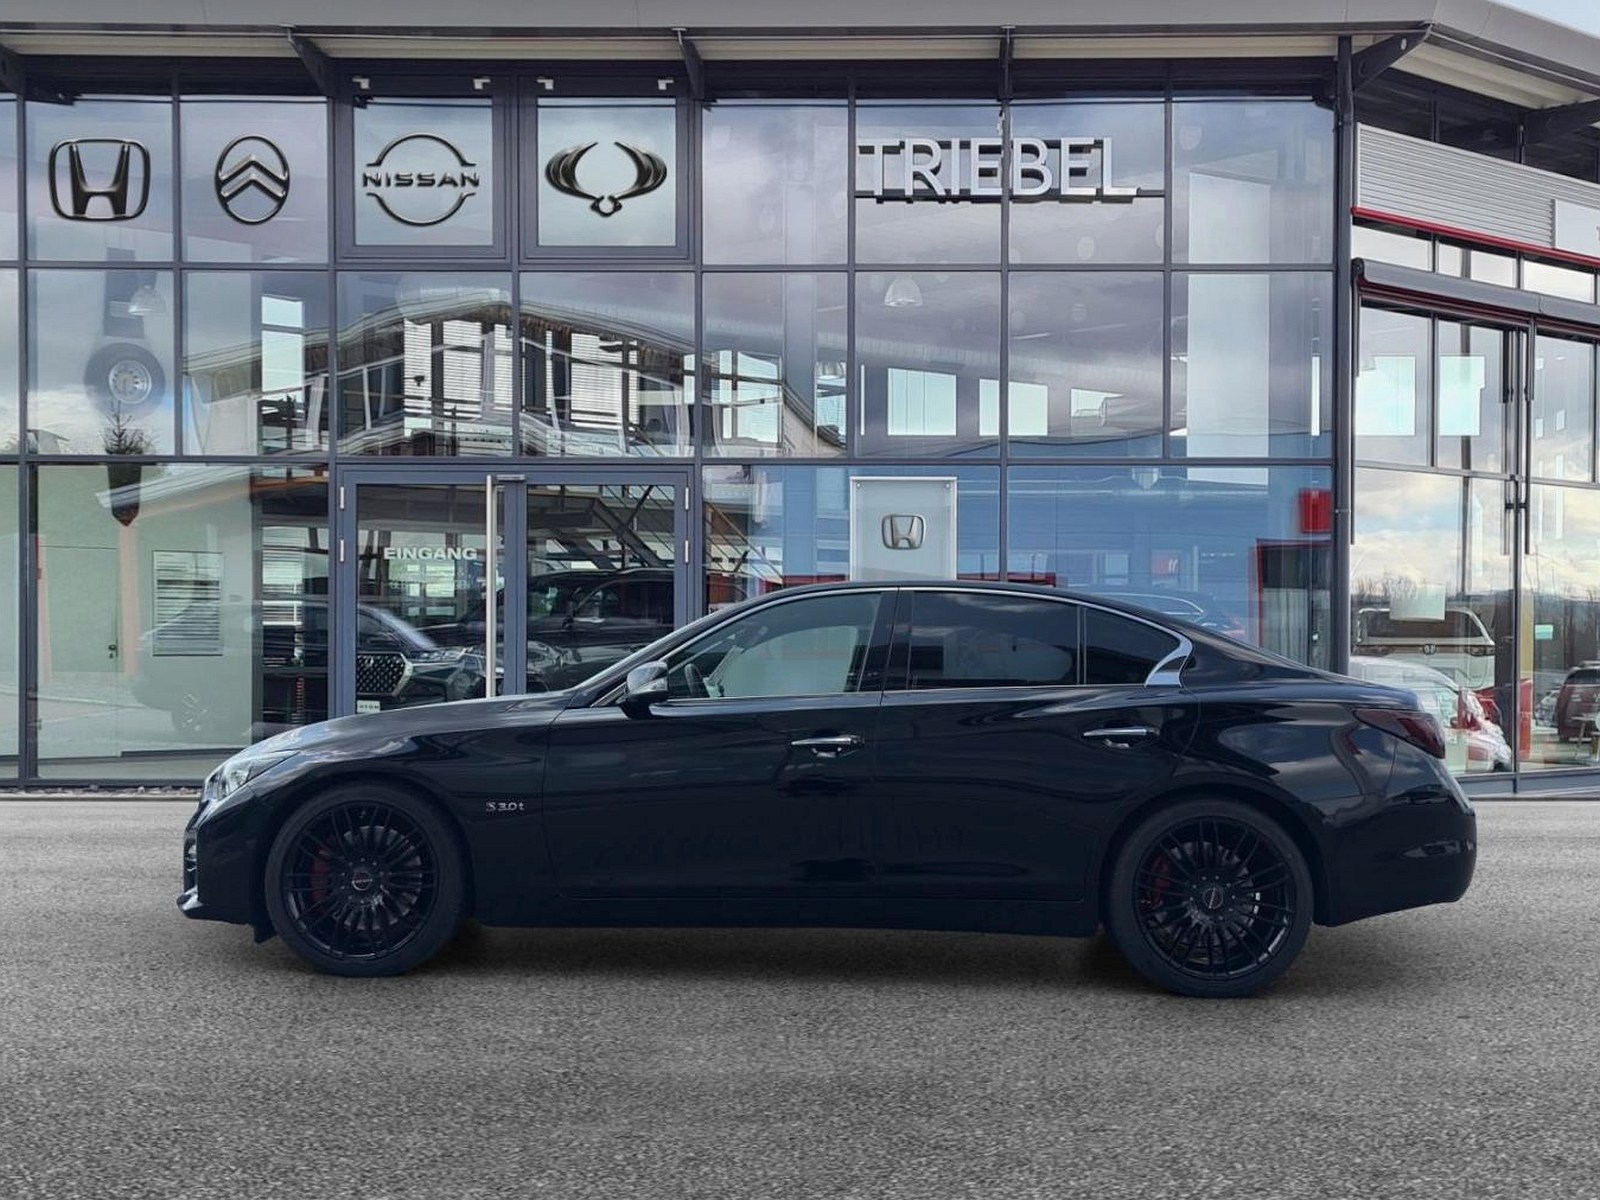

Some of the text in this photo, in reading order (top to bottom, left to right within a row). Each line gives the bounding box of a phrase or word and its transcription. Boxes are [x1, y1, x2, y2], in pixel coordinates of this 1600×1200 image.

[857, 137, 1138, 199] TRIEBEL
[362, 172, 480, 188] NISSAN
[383, 547, 478, 560] EINGANG
